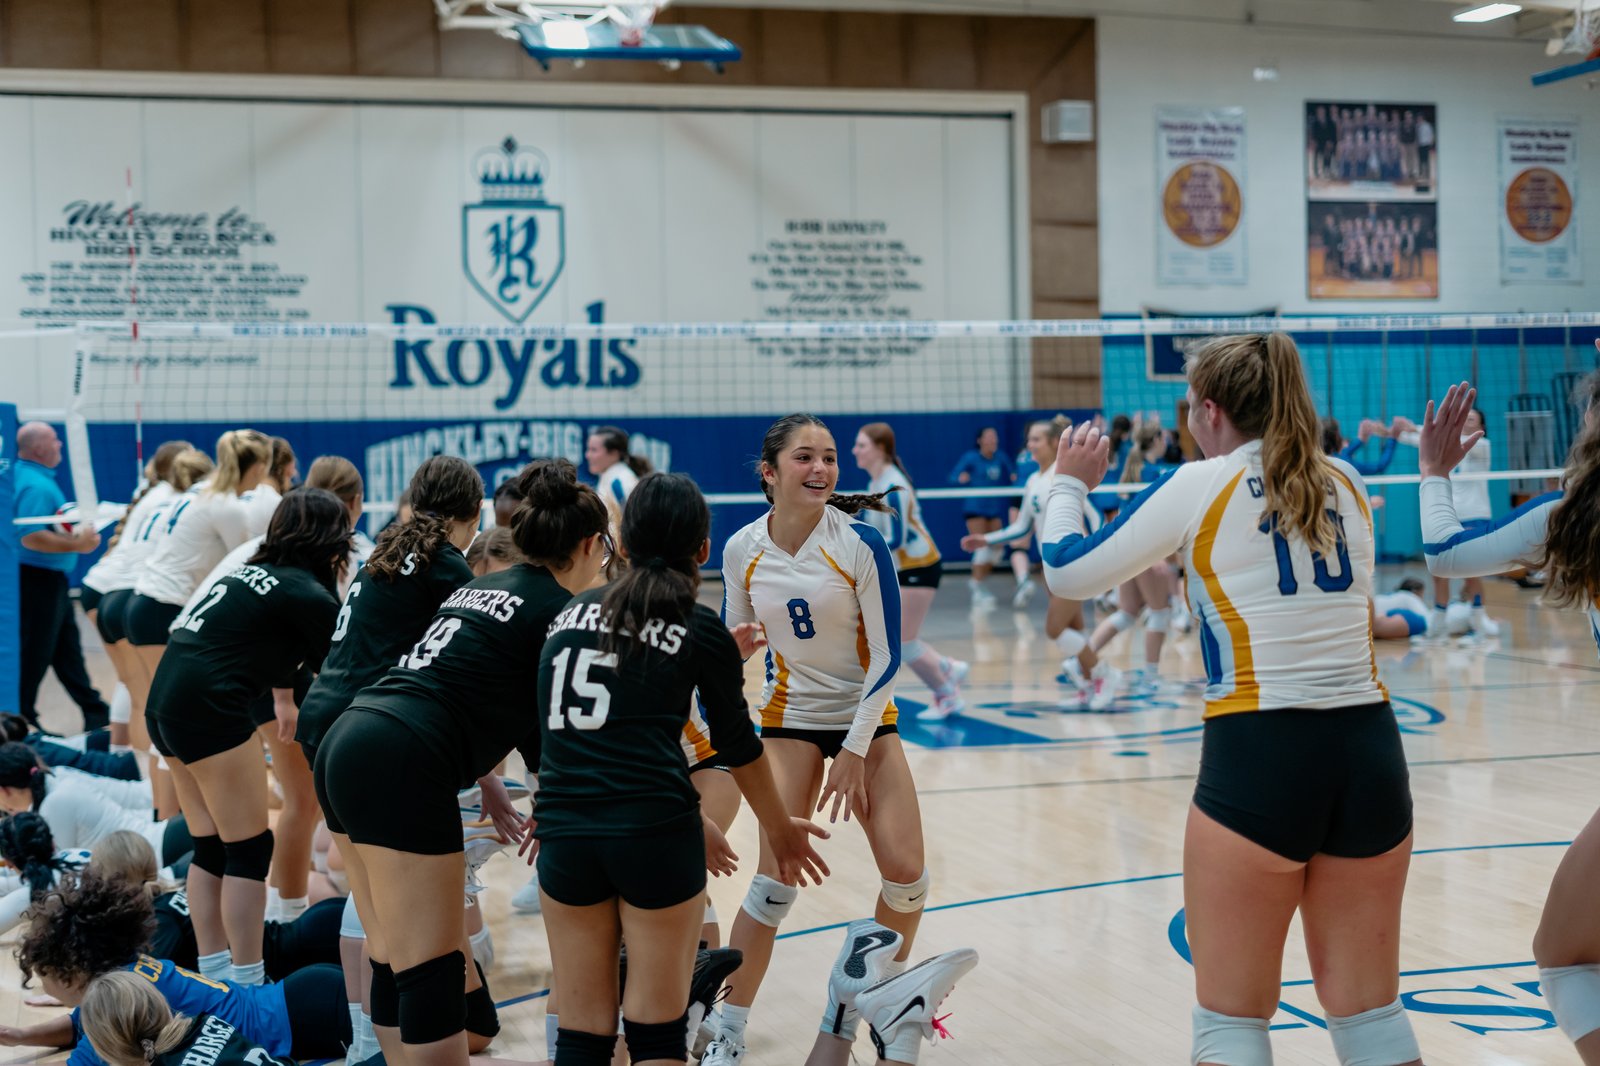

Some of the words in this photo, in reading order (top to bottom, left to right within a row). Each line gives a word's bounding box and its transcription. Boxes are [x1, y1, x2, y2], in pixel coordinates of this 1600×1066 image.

[63, 199, 208, 228] Welcome
[217, 206, 249, 228] to
[86, 245, 141, 257] HIGH
[150, 245, 240, 258] SCHOOL
[217, 231, 277, 246] ROCK
[385, 299, 642, 411] Royals
[1258, 508, 1354, 596] 10
[786, 598, 816, 640] 8
[548, 647, 619, 731] 15
